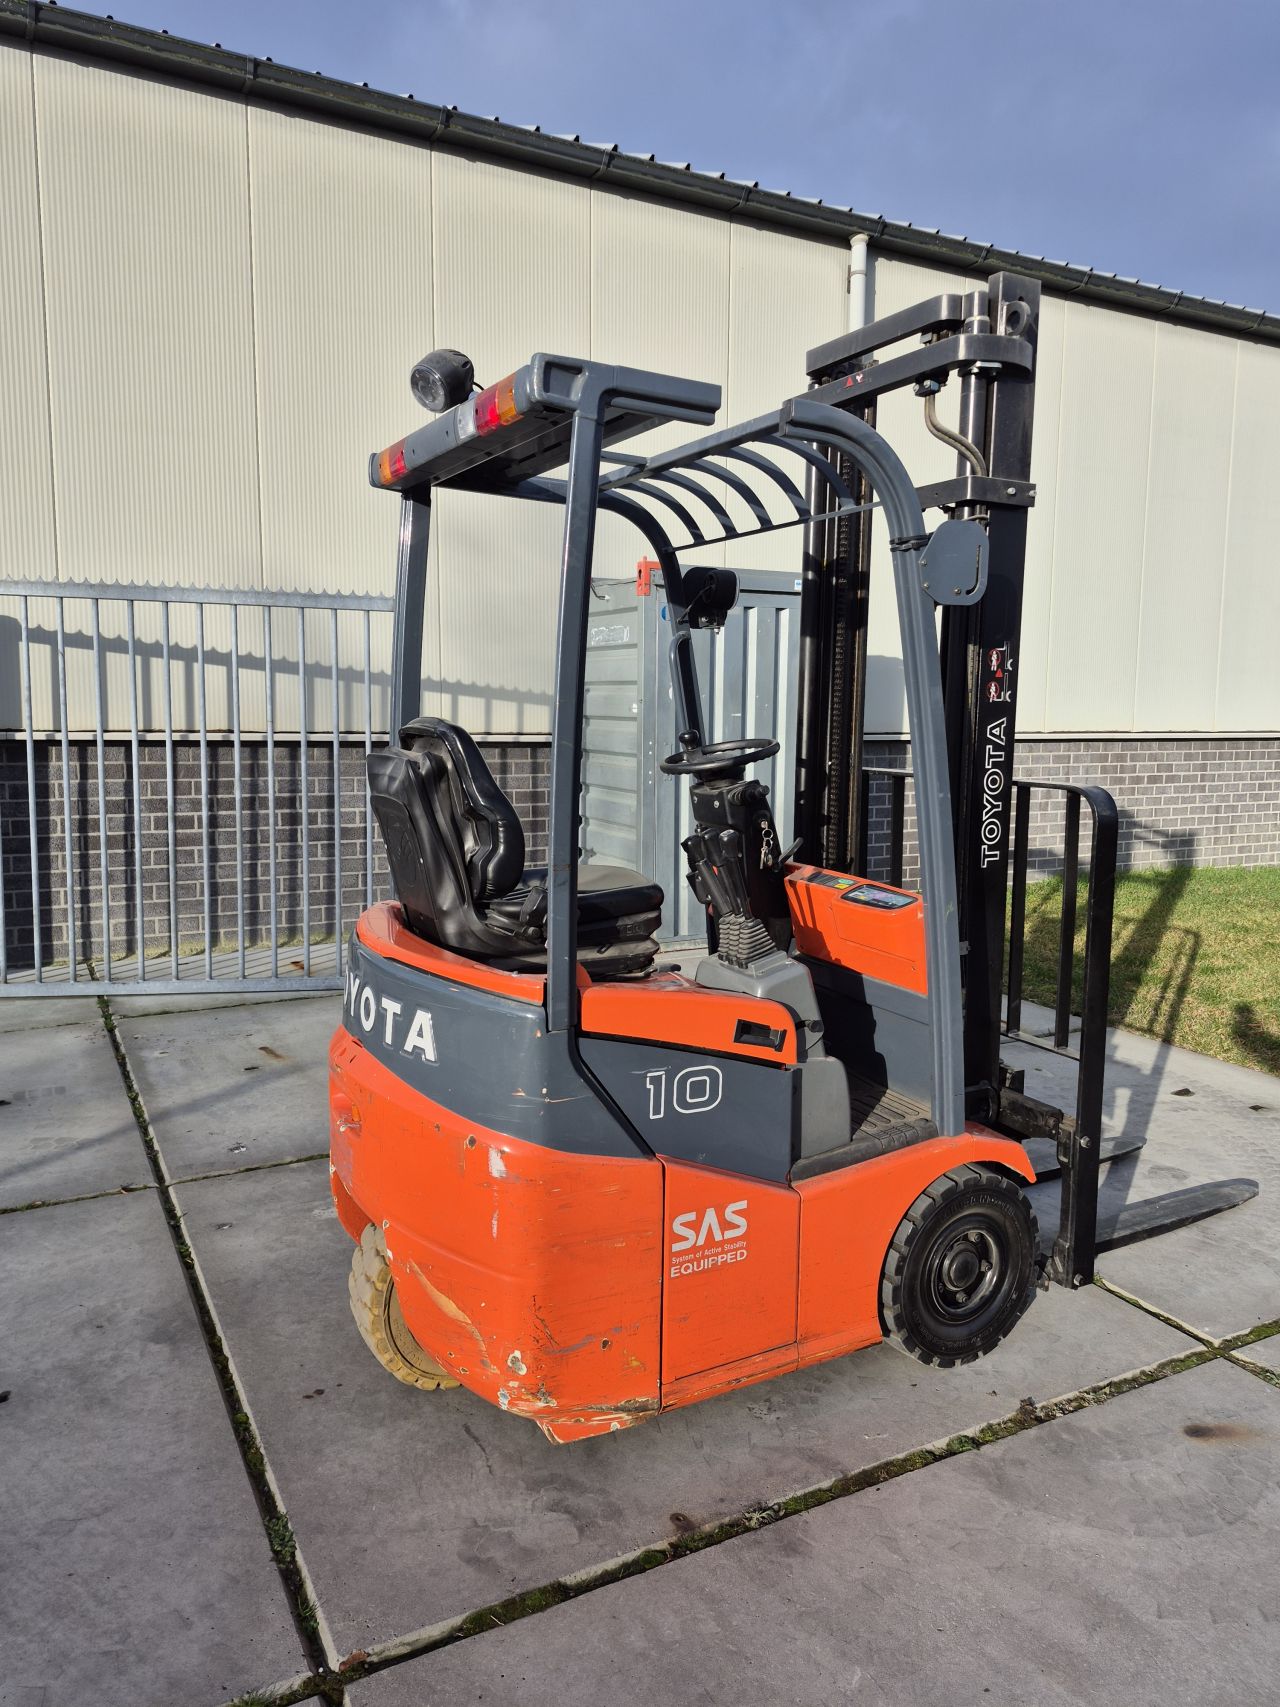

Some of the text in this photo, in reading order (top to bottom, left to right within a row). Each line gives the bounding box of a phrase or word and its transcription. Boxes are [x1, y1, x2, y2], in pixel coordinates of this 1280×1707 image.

[981, 717, 1007, 868] TOYOTA
[646, 1065, 722, 1119] 10
[672, 1200, 748, 1252] SAS
[671, 1249, 748, 1278] EQUIPPED
[672, 1240, 747, 1265] System of Active Stability
